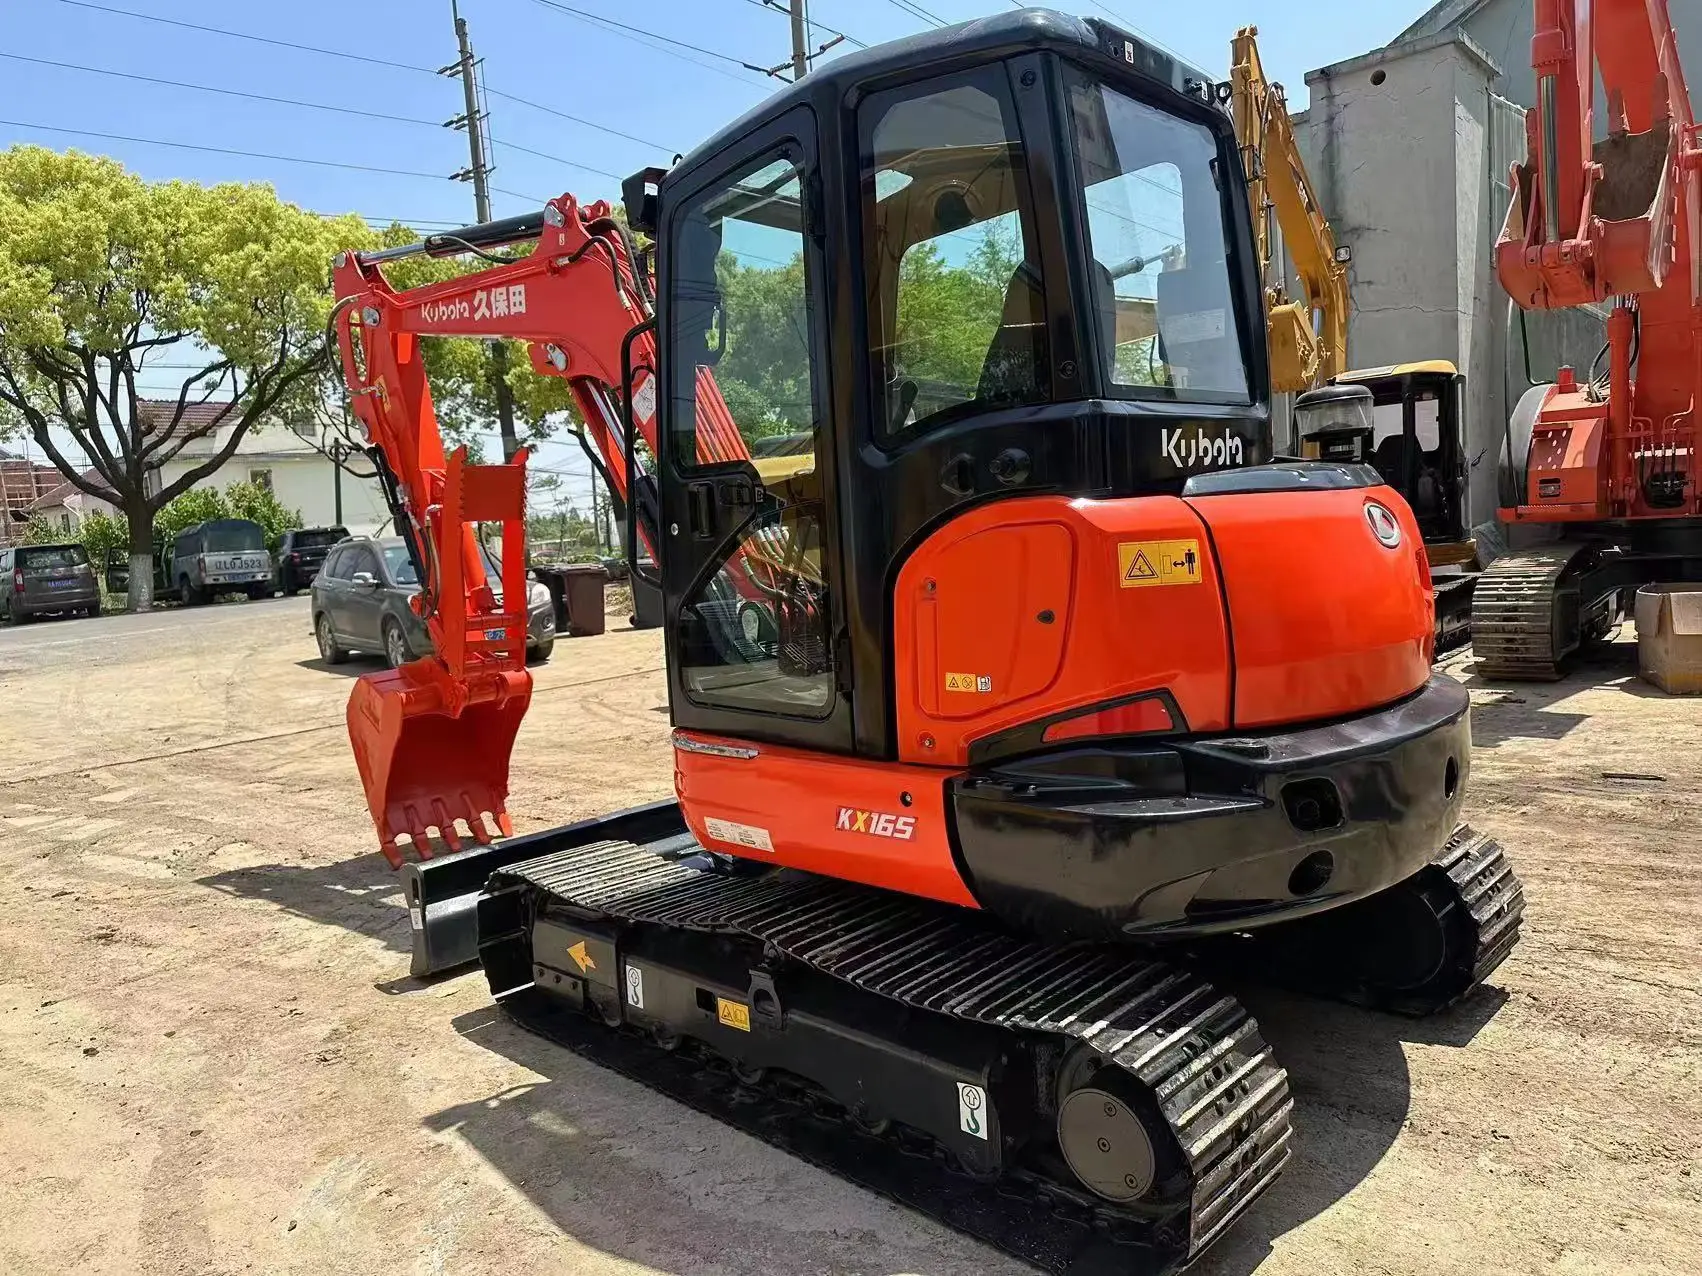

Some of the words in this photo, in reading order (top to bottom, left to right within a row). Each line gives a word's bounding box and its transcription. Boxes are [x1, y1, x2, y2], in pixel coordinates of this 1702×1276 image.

[421, 298, 470, 323] Kubota
[473, 284, 526, 321] 久保田
[1161, 427, 1243, 468] Kubota
[838, 807, 916, 840] KX165
